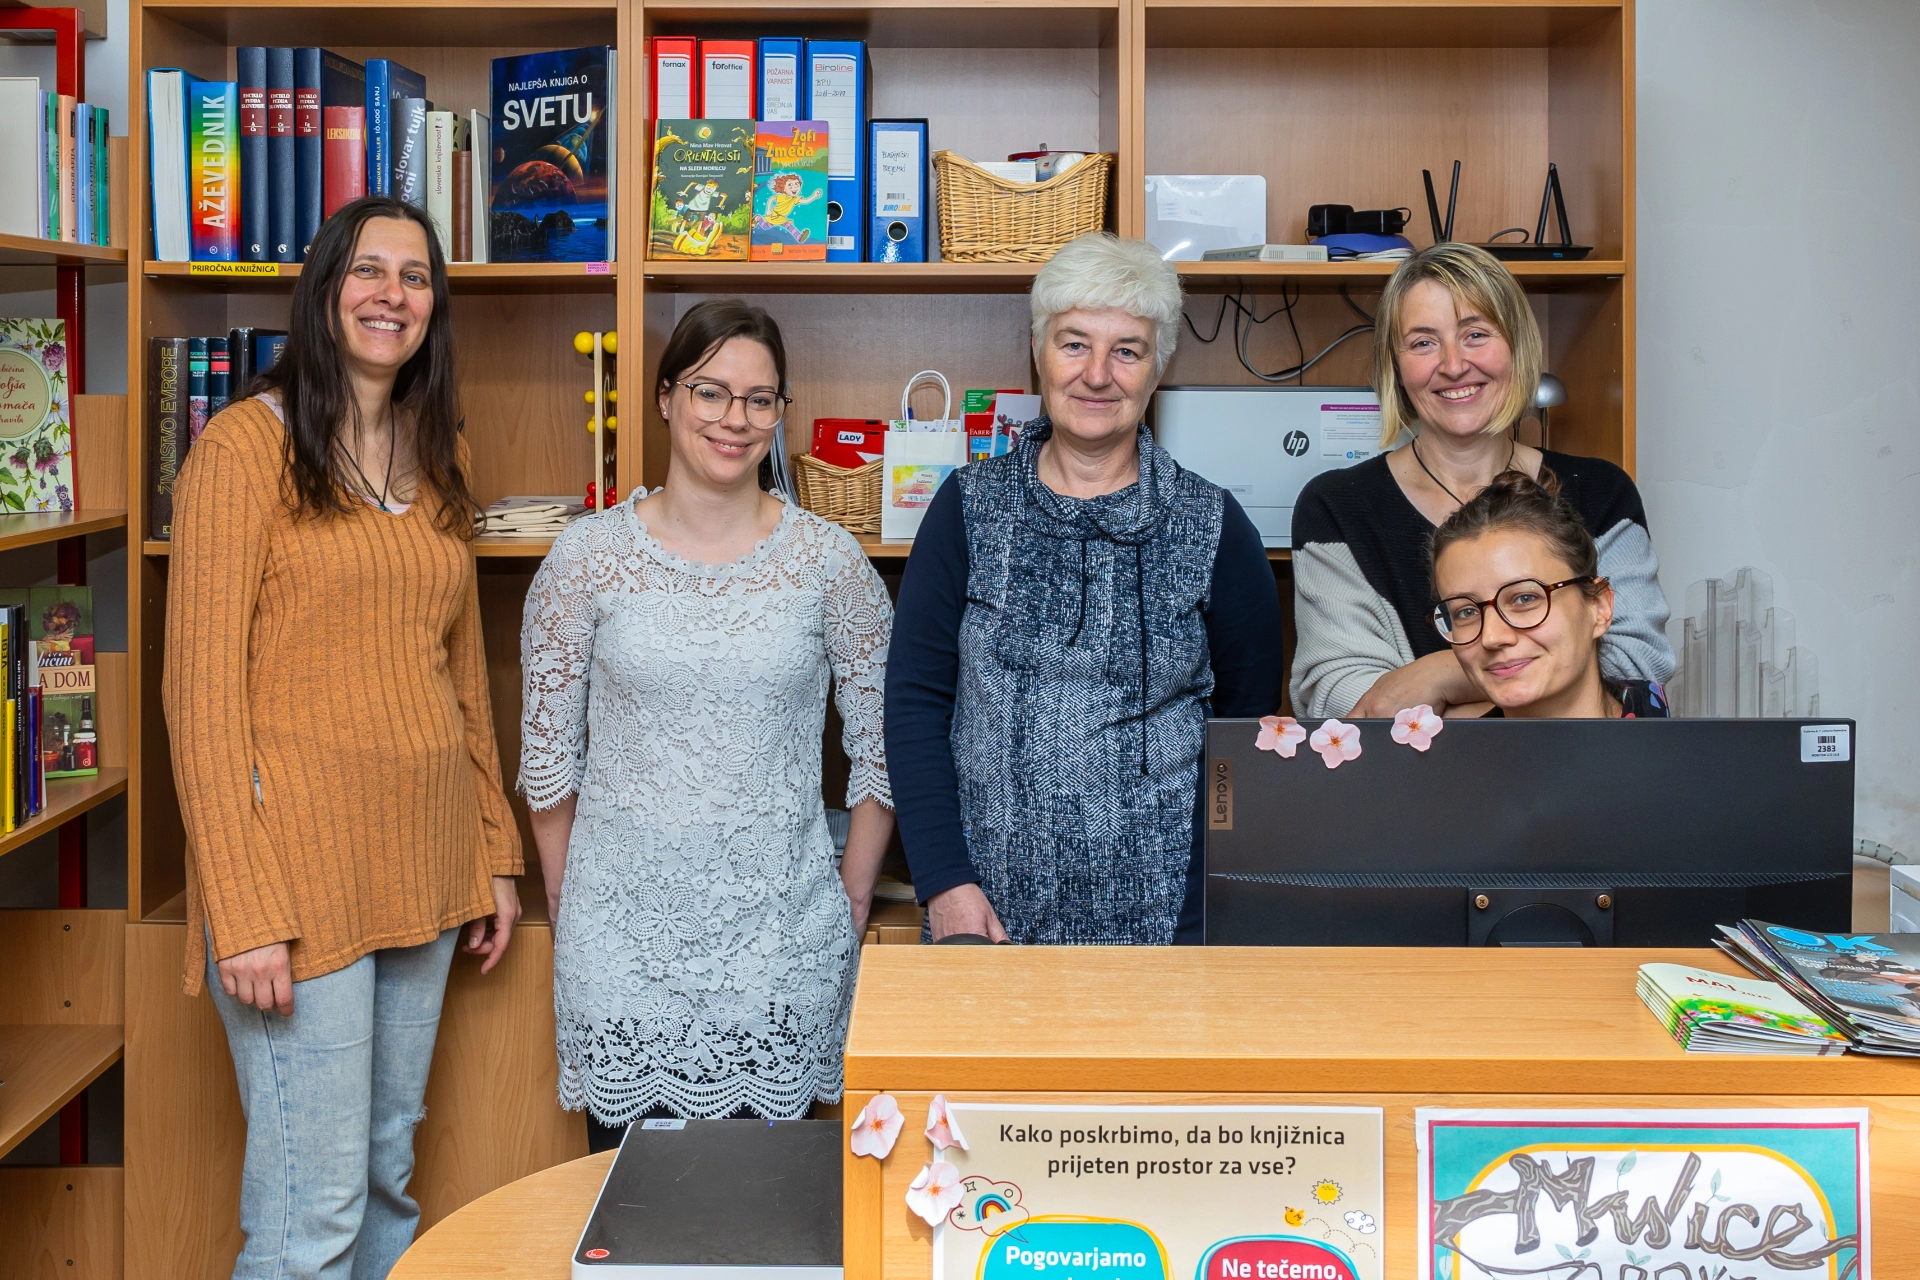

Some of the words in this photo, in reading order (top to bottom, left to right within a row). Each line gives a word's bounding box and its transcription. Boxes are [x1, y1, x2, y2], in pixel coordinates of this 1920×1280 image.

[662, 60, 686, 68] fornax
[815, 63, 853, 72] Biroline
[508, 78, 548, 92] NAJLEPŠA
[549, 76, 579, 88] KNJIGA
[580, 74, 588, 84] O
[503, 92, 593, 130] SVETU
[327, 128, 361, 140] LEKSIKON
[394, 136, 414, 181] slovar
[406, 105, 425, 134] tujk
[435, 129, 444, 163] književnost
[765, 142, 815, 158] Zmeda
[199, 95, 226, 229] AŽEVEDNIK
[400, 171, 417, 202] očni
[192, 263, 233, 273] PRIROČNA
[234, 264, 276, 273] KNJIŽNICA
[0, 376, 26, 399] oljša
[161, 347, 178, 413] EVROPE
[0, 401, 35, 410] mača
[0, 414, 24, 423] ravila
[839, 434, 861, 442] LADY
[1285, 430, 1309, 457] hp
[157, 417, 178, 495] ŽIVALSTVO
[38, 651, 75, 667] bičini
[39, 672, 49, 689] A
[54, 671, 91, 688] DOM
[1213, 763, 1228, 824] Lenovo
[1000, 1123, 1053, 1144] Kako
[1059, 1124, 1180, 1149] poskrbimo,
[1187, 1125, 1212, 1145] da
[1218, 1125, 1244, 1145] bo
[1250, 1125, 1346, 1150] knjižnica
[1047, 1155, 1130, 1179] prijeten
[1136, 1156, 1213, 1179] prostor
[1219, 1160, 1243, 1175] za
[1248, 1157, 1297, 1175] vse?
[1006, 1245, 1146, 1271] Pogovarjamo
[1222, 1258, 1251, 1276] Ne
[1256, 1260, 1343, 1280] tečemo,
